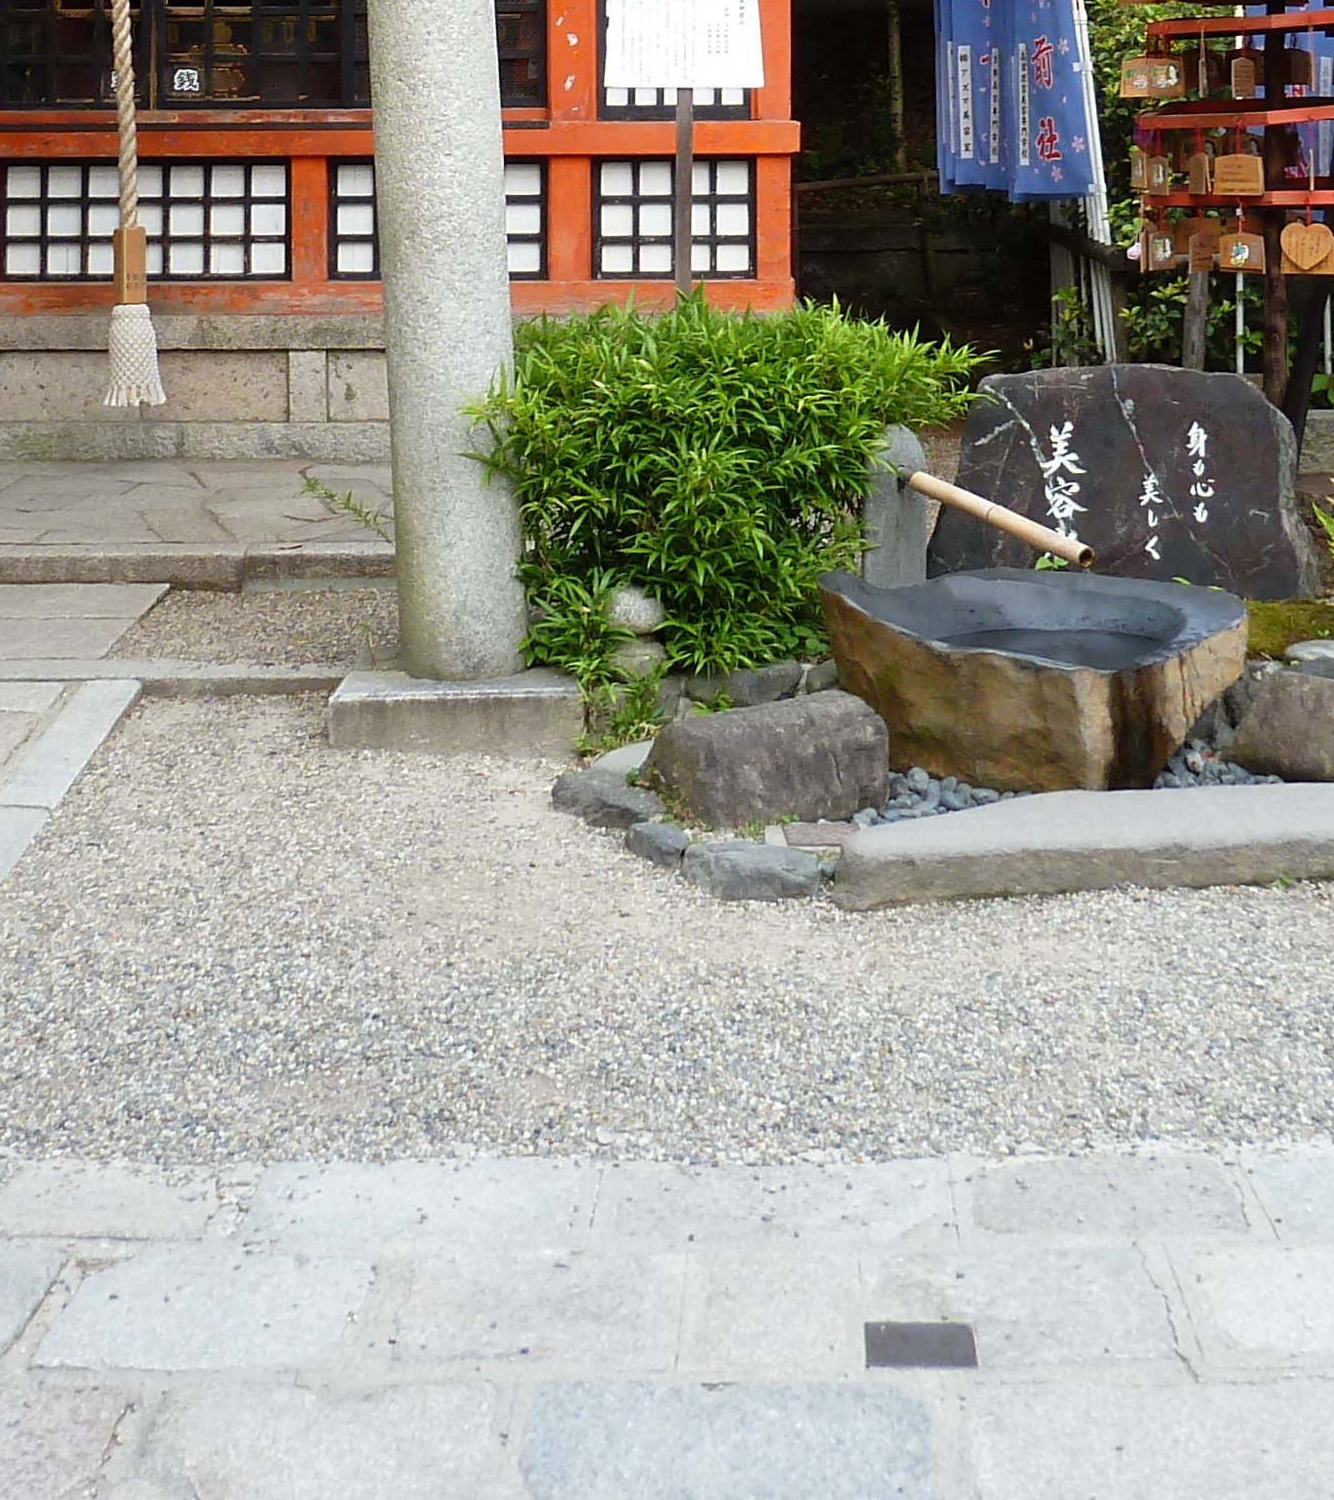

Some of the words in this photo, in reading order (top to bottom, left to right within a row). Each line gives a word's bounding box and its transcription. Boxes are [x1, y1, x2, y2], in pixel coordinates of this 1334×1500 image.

[1139, 472, 1163, 560] 美しく
[1186, 421, 1215, 523] 身も心も
